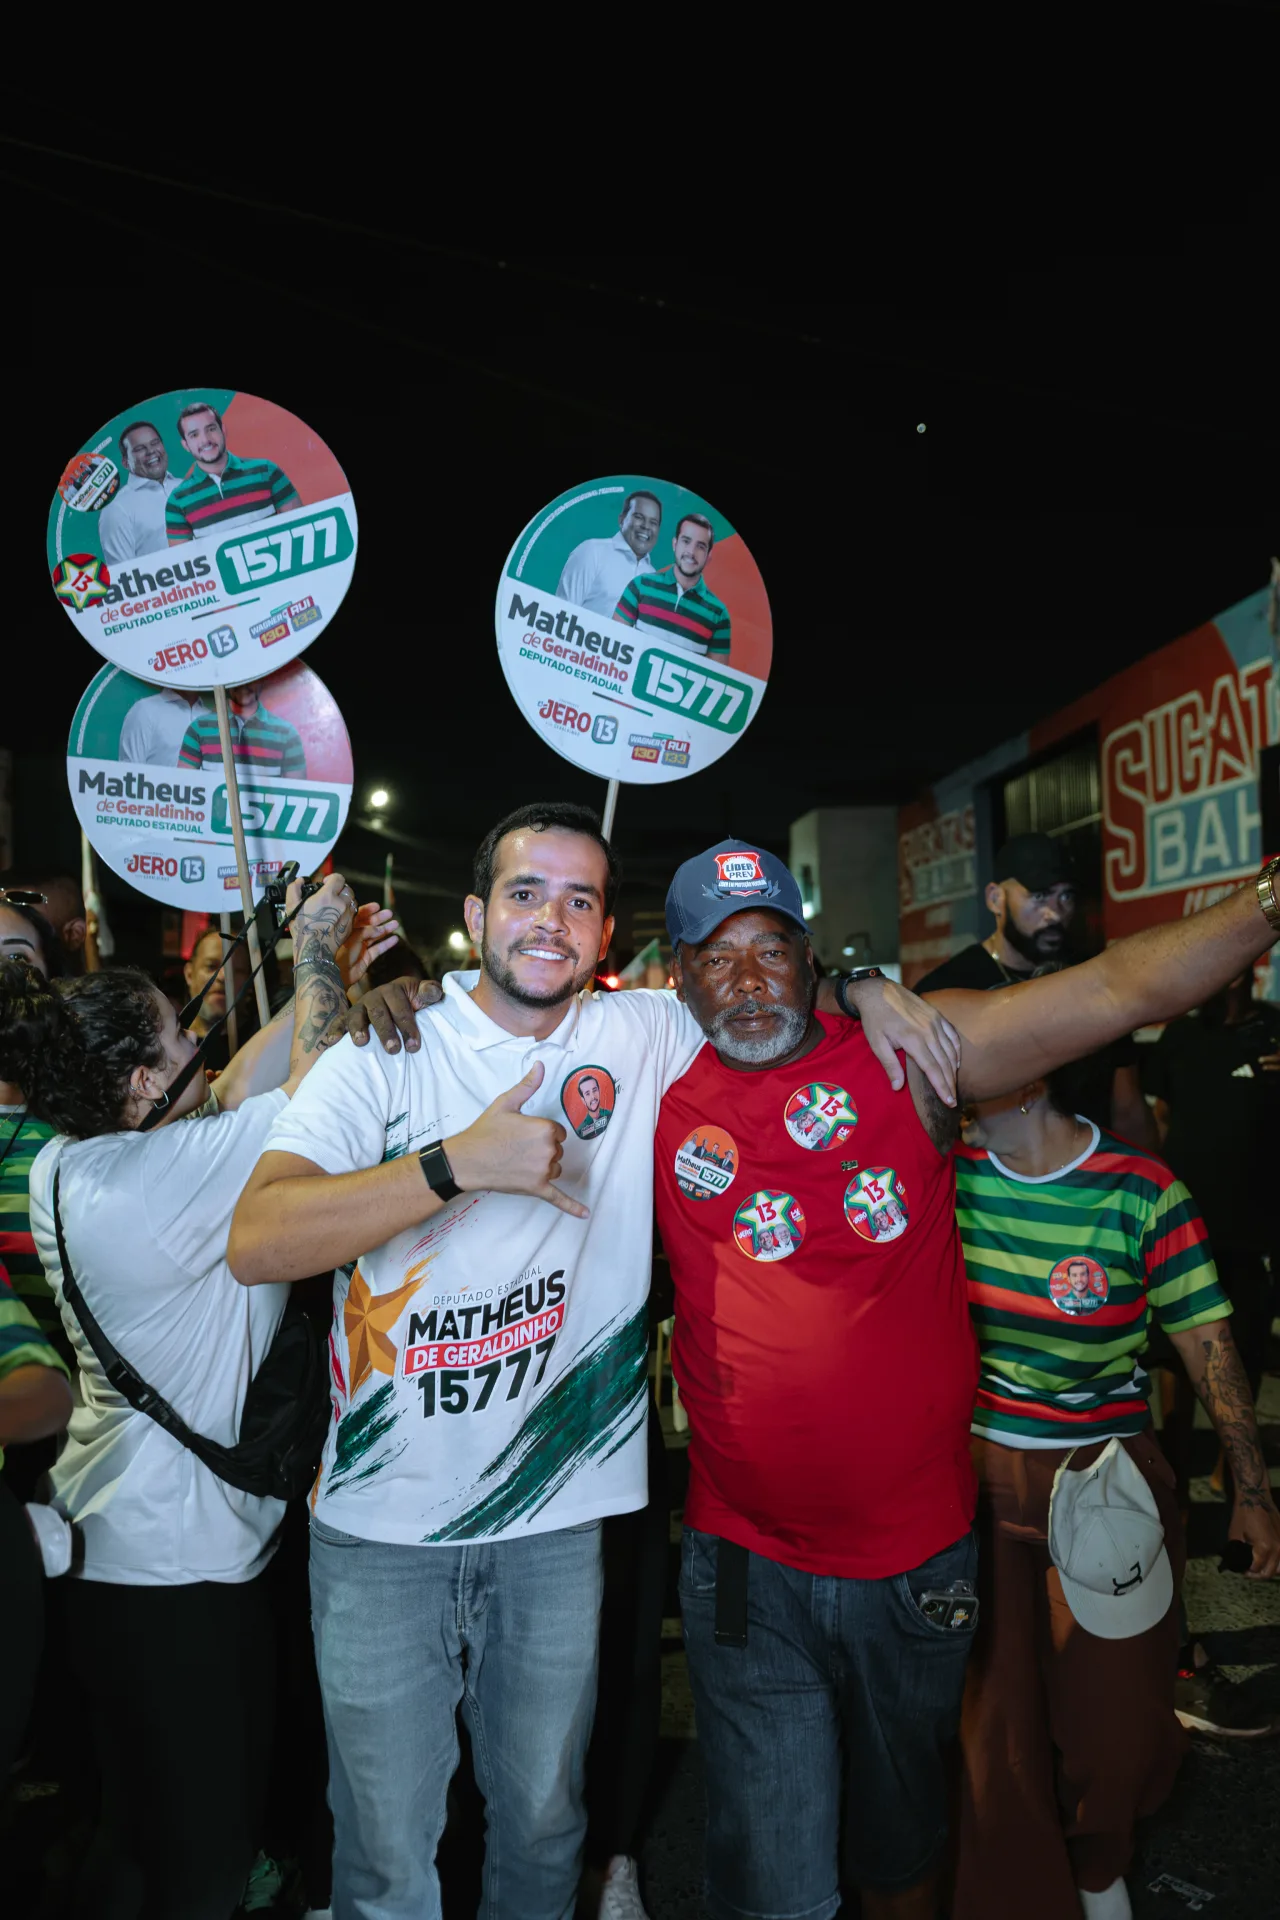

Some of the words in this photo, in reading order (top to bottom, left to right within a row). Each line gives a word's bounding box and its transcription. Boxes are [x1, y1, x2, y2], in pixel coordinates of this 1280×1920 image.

[224, 516, 338, 585] 15777
[71, 570, 94, 593] 13
[75, 555, 211, 614] atheus
[100, 608, 119, 625] de
[120, 579, 217, 618] Geraldinho
[290, 597, 311, 616] RUI
[103, 611, 163, 637] DEPUTADO
[163, 594, 220, 618] ESTADUAL
[211, 628, 235, 654] 13
[260, 625, 286, 646] 130
[507, 592, 635, 665] Matheus
[153, 638, 208, 672] JERO
[522, 631, 541, 649] de
[542, 637, 629, 682] Geraldinho
[519, 647, 573, 676] DEPUTADO
[573, 669, 625, 695] ESTADUAL
[645, 654, 745, 725] 15777
[539, 699, 592, 733] JERO
[596, 717, 616, 742] 13
[633, 747, 657, 760] 130
[664, 752, 687, 765] 133
[667, 740, 687, 752] RUI
[78, 769, 206, 806] Matheus
[1102, 655, 1280, 903] SUCAT
[96, 798, 115, 813] de
[116, 800, 205, 822] Geraldinho
[96, 815, 151, 829] DEPUTADO
[151, 821, 203, 834] ESTADUAL
[127, 854, 178, 877] JERO
[184, 859, 203, 880] 13
[259, 862, 279, 873] RUI
[725, 862, 754, 872] LÍDER
[729, 871, 754, 879] PREV
[820, 1095, 844, 1117] 13
[677, 1154, 701, 1172] Matheus
[702, 1168, 727, 1187] 15777
[862, 1179, 885, 1204] 13
[755, 1201, 777, 1223] 13
[738, 1228, 753, 1239] JERO
[433, 1288, 494, 1306] DEPUTADO
[497, 1265, 542, 1295] ESTADUAL
[408, 1269, 566, 1346] MATHEUS
[413, 1347, 438, 1370] DE
[443, 1310, 560, 1365] GERALDINHO
[417, 1333, 557, 1419] 15777
